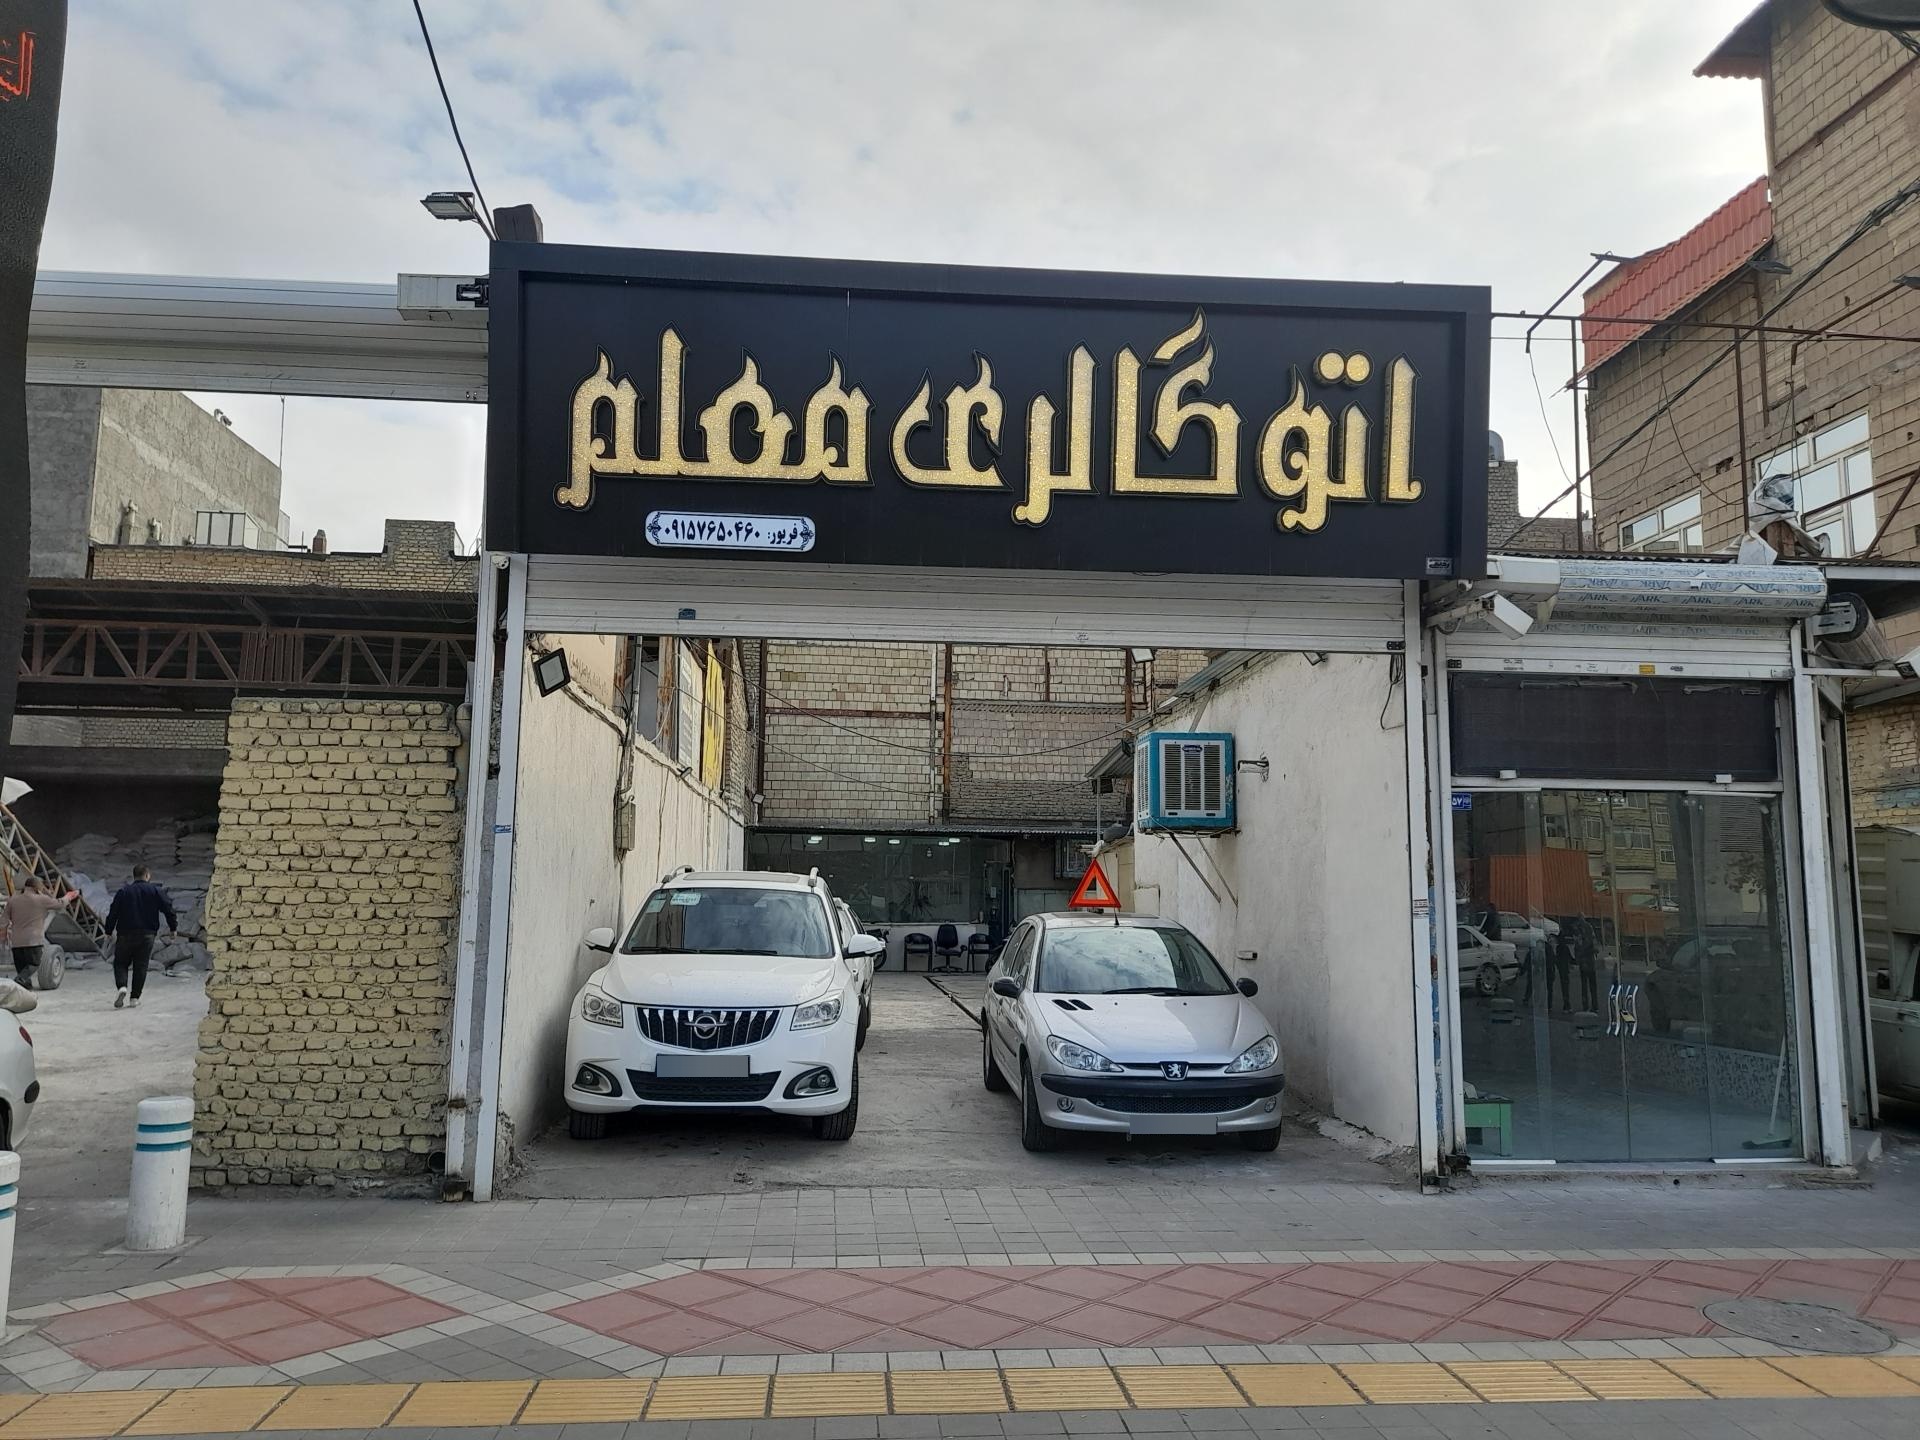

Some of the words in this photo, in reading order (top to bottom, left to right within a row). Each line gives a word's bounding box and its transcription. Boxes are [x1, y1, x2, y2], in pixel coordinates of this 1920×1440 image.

[553, 321, 875, 512] معلم
[890, 306, 1246, 528] گالری
[1256, 350, 1426, 534] اتو
[664, 518, 761, 543] ۰۹۱۵۷۶۵۰۴۶۰
[767, 522, 799, 545] فریور:
